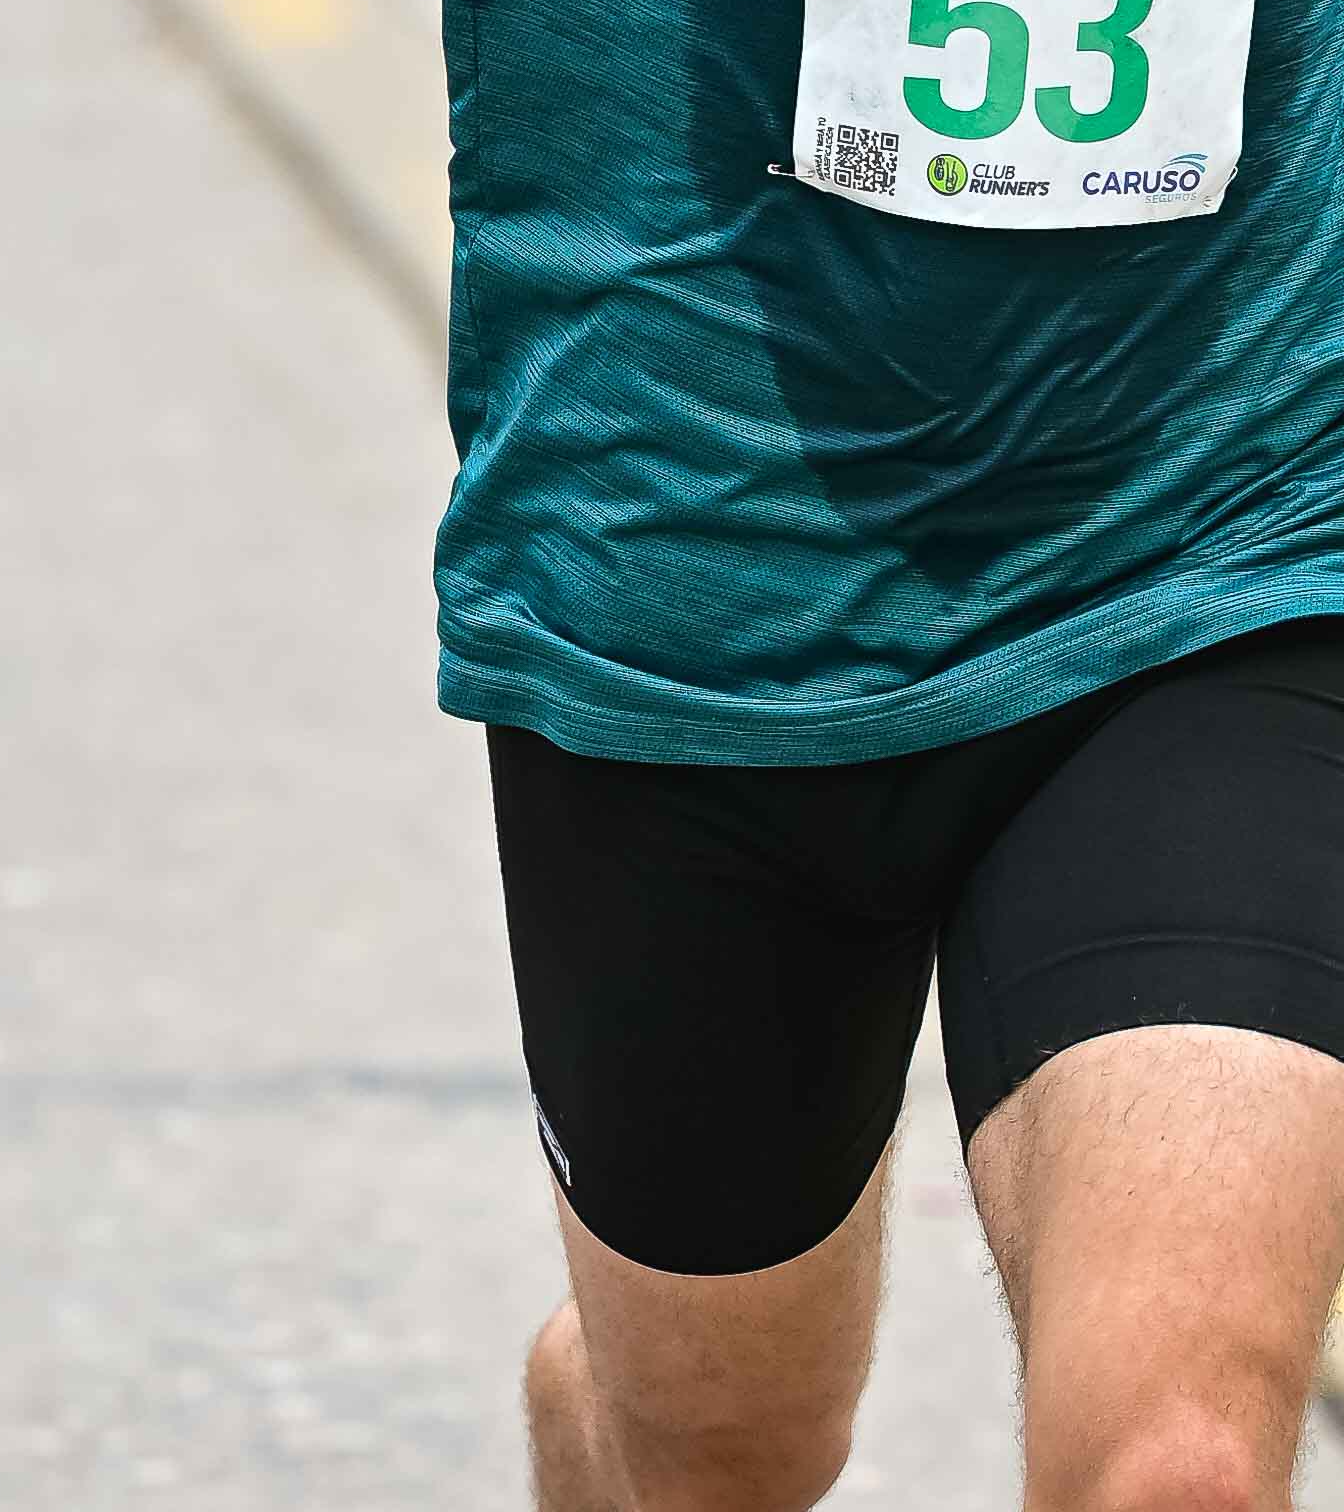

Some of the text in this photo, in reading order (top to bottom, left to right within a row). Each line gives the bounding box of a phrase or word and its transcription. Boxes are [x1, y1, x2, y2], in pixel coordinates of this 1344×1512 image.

[972, 163, 1016, 179] CLUB
[968, 178, 1050, 196] RUNNER'S
[1082, 169, 1201, 195] CARUSO
[1144, 192, 1197, 204] SEGUROS
